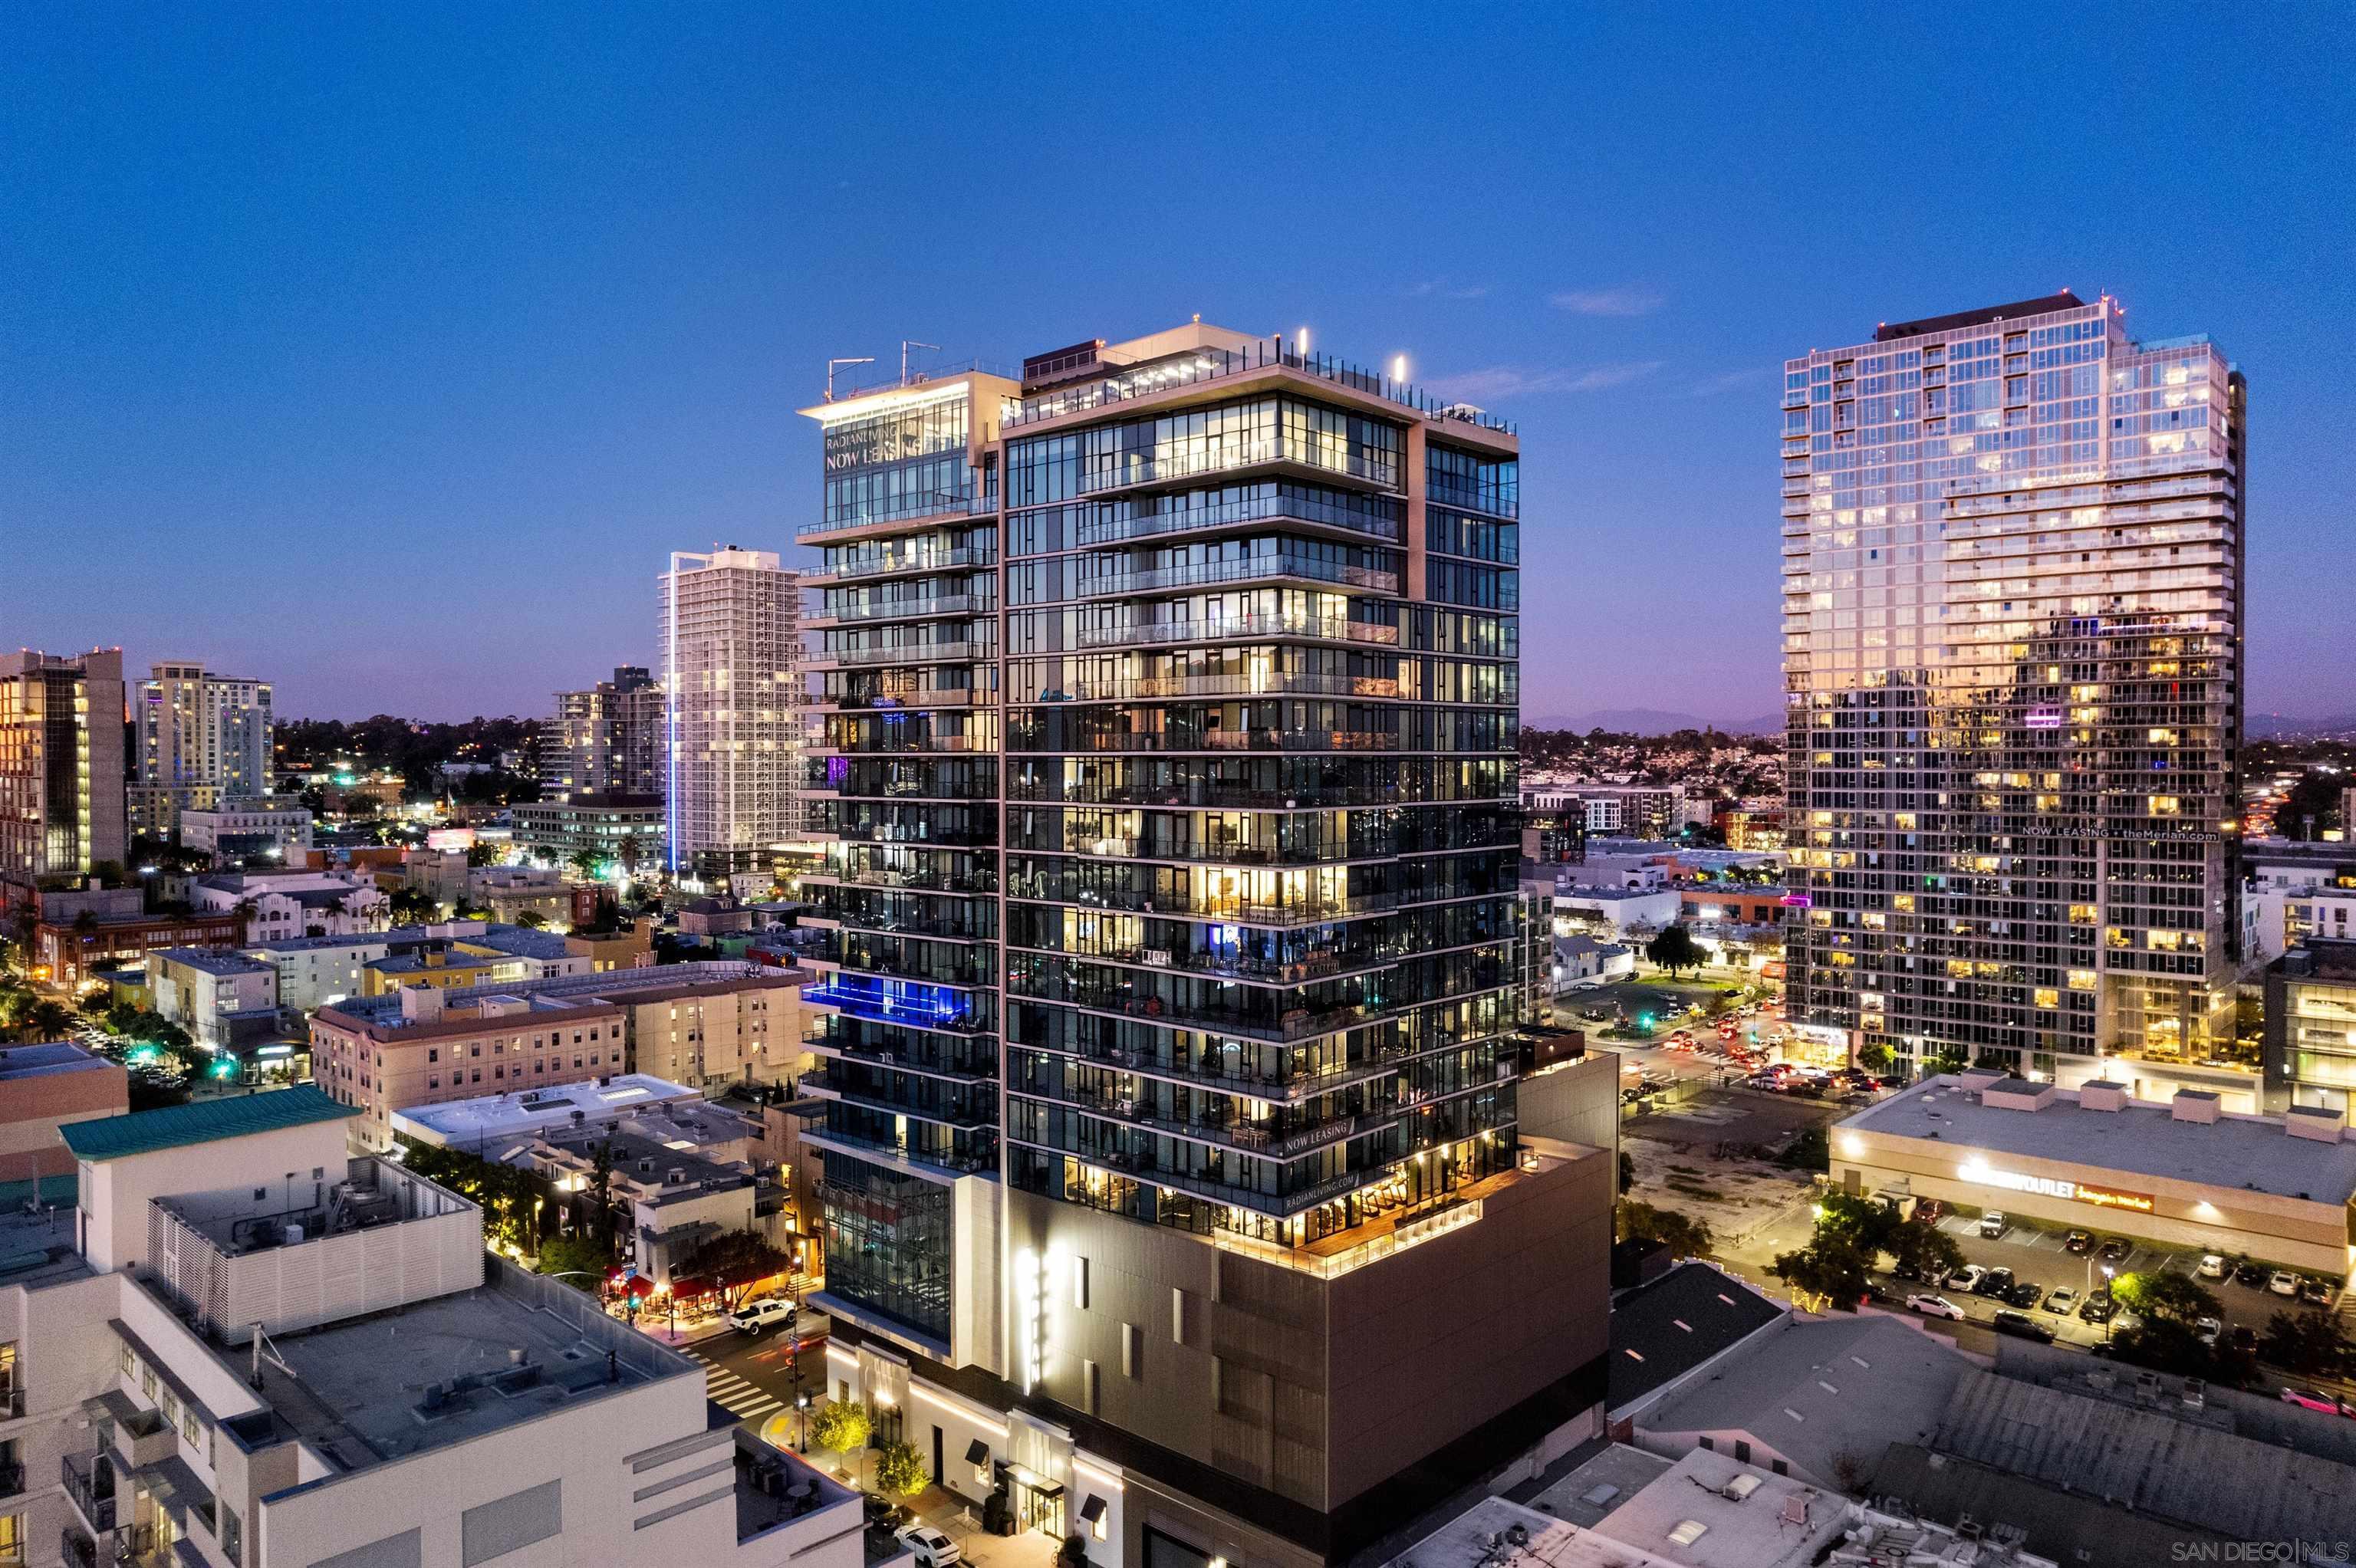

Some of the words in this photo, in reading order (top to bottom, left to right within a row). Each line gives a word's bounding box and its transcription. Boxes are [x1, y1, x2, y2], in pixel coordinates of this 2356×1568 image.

[827, 450, 859, 471] NOW
[864, 436, 921, 465] LEASNG
[2056, 828, 2109, 837] LEASING
[2123, 830, 2217, 841] theMerian.com
[1286, 1136, 1308, 1152] NOW
[1311, 1122, 1347, 1144] LEASING
[1287, 1175, 1354, 1209] RADIANLIVING.COM
[2025, 1177, 2075, 1198] OUTLET
